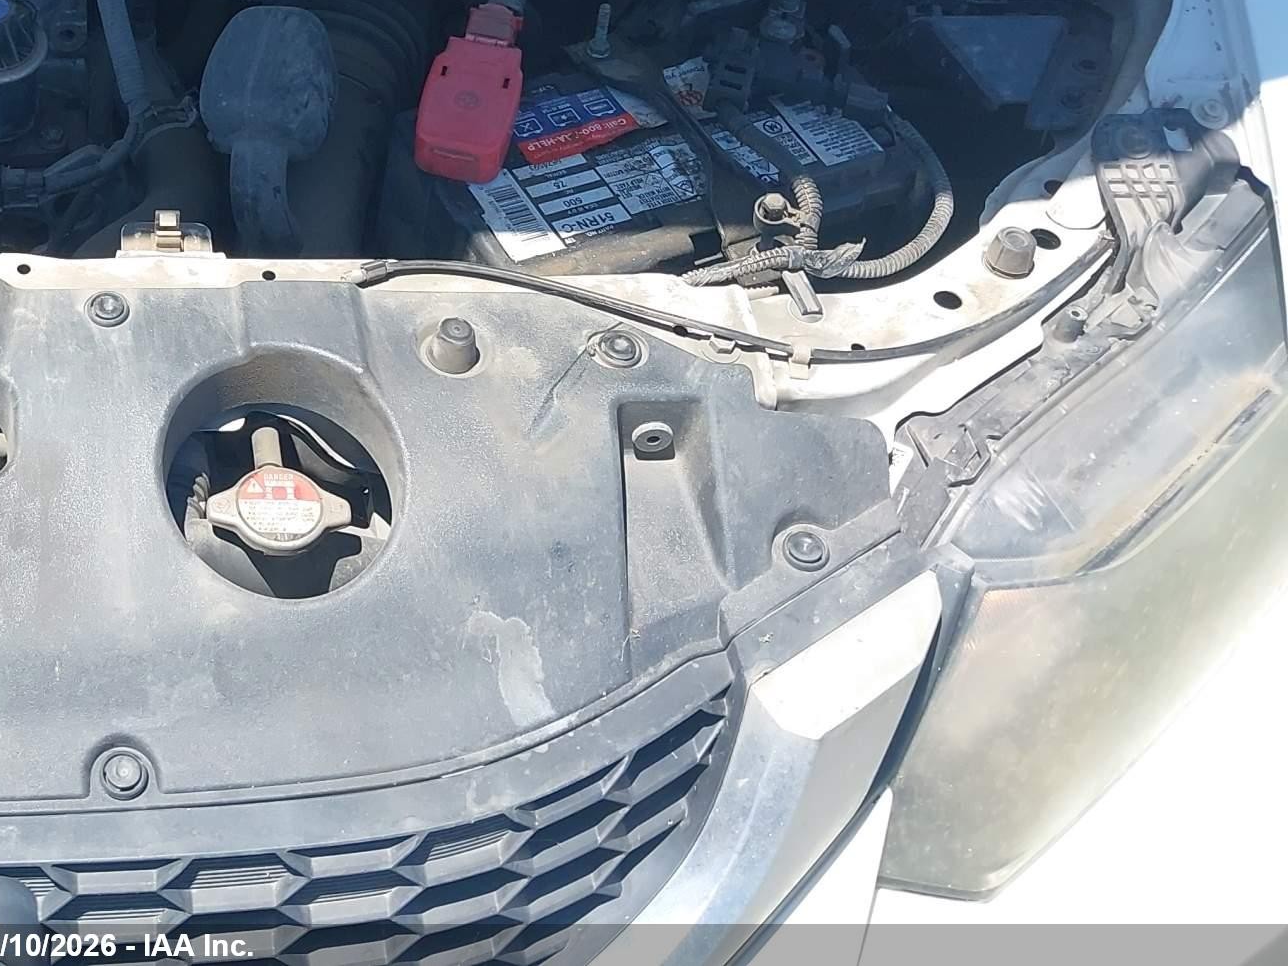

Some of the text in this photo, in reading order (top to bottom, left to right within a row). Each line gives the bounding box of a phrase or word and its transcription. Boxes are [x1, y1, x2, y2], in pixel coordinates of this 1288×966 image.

[603, 118, 627, 130] Call:
[553, 180, 567, 190] 75
[562, 196, 583, 208] 500
[560, 212, 615, 233] 51RN-C
